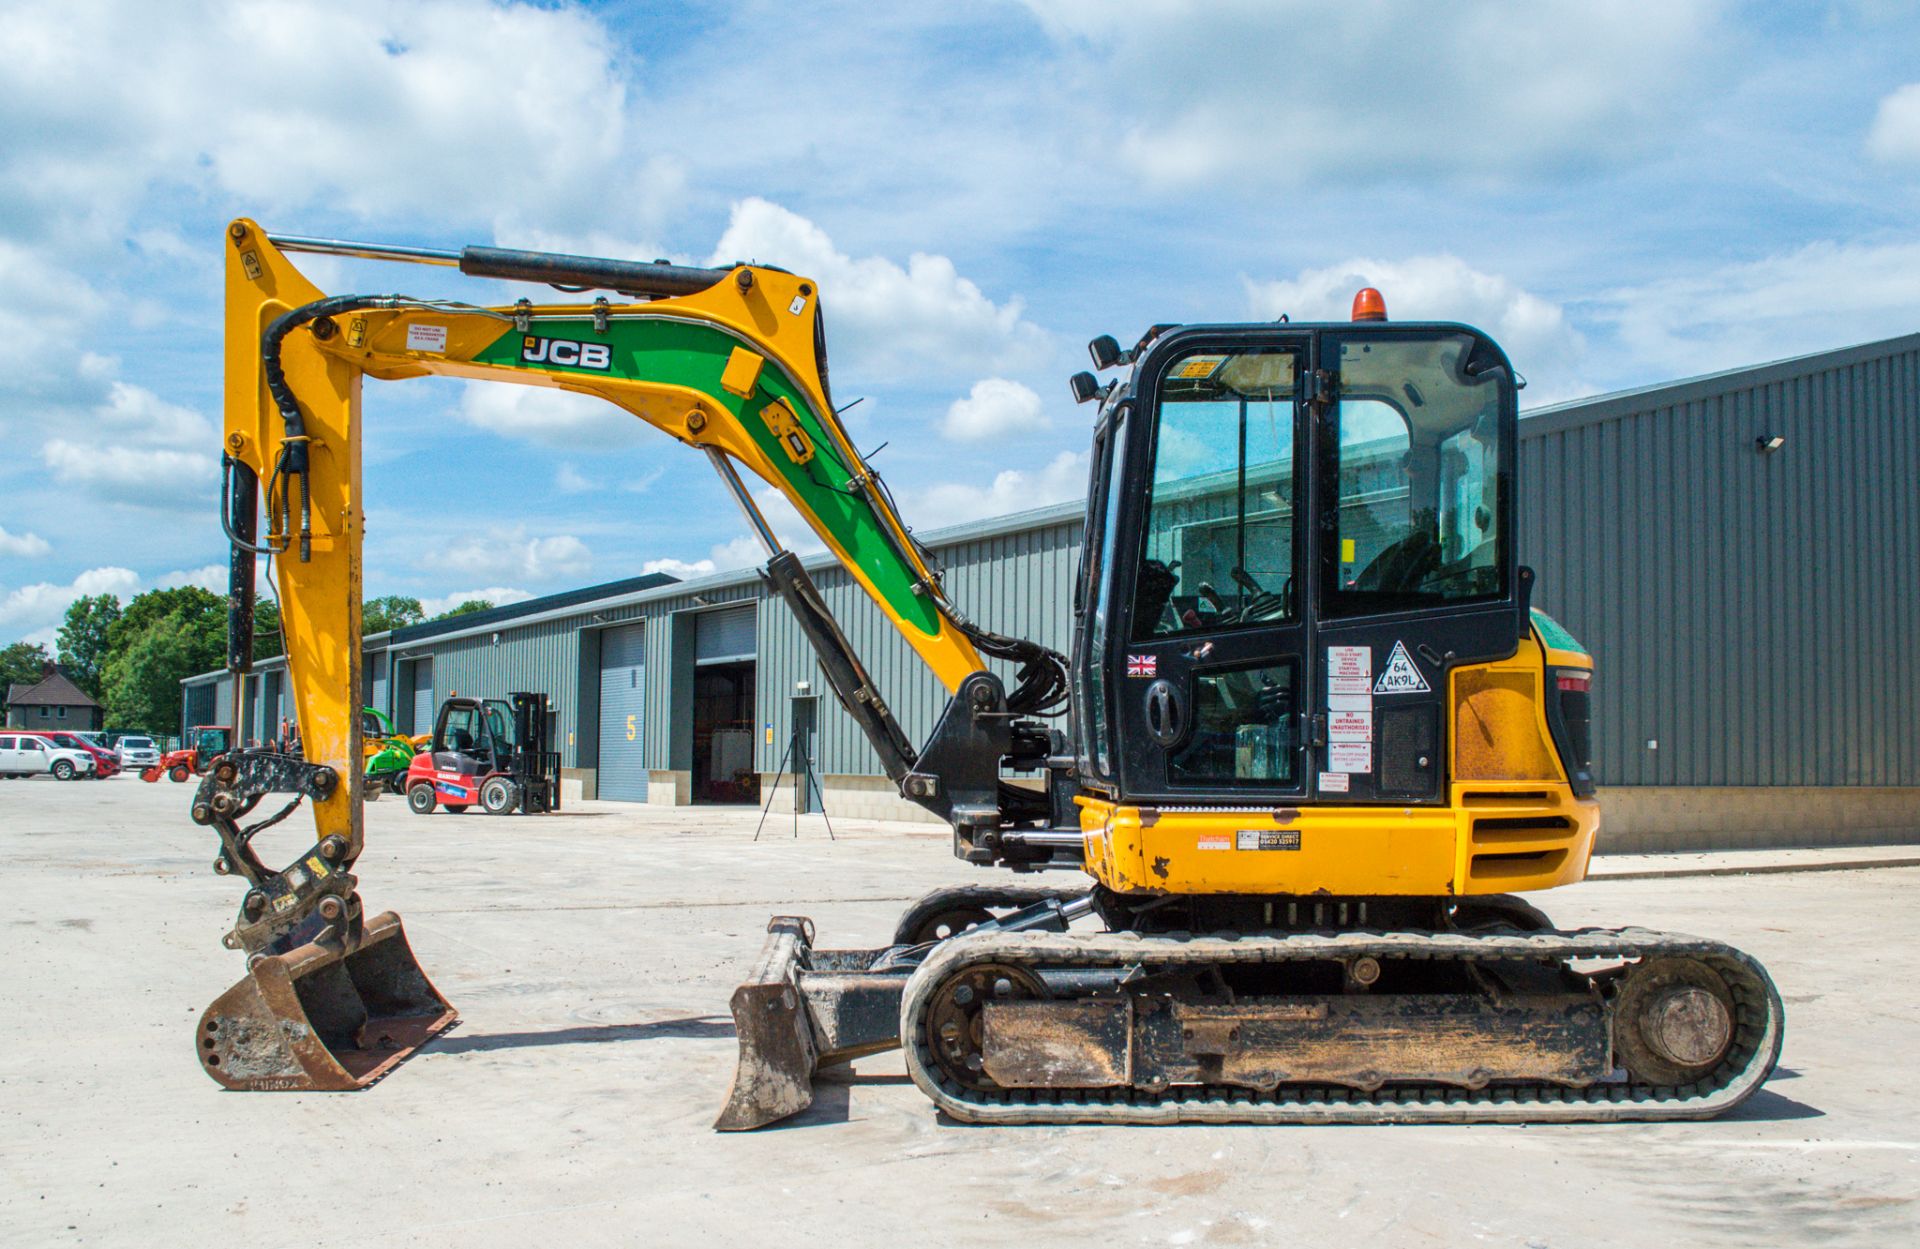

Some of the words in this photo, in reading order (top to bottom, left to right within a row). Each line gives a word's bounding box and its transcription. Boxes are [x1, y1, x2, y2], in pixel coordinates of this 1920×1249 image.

[523, 338, 610, 369] JCB
[1394, 662, 1407, 672] 64
[1387, 675, 1416, 687] AK9L
[626, 714, 636, 741] 5
